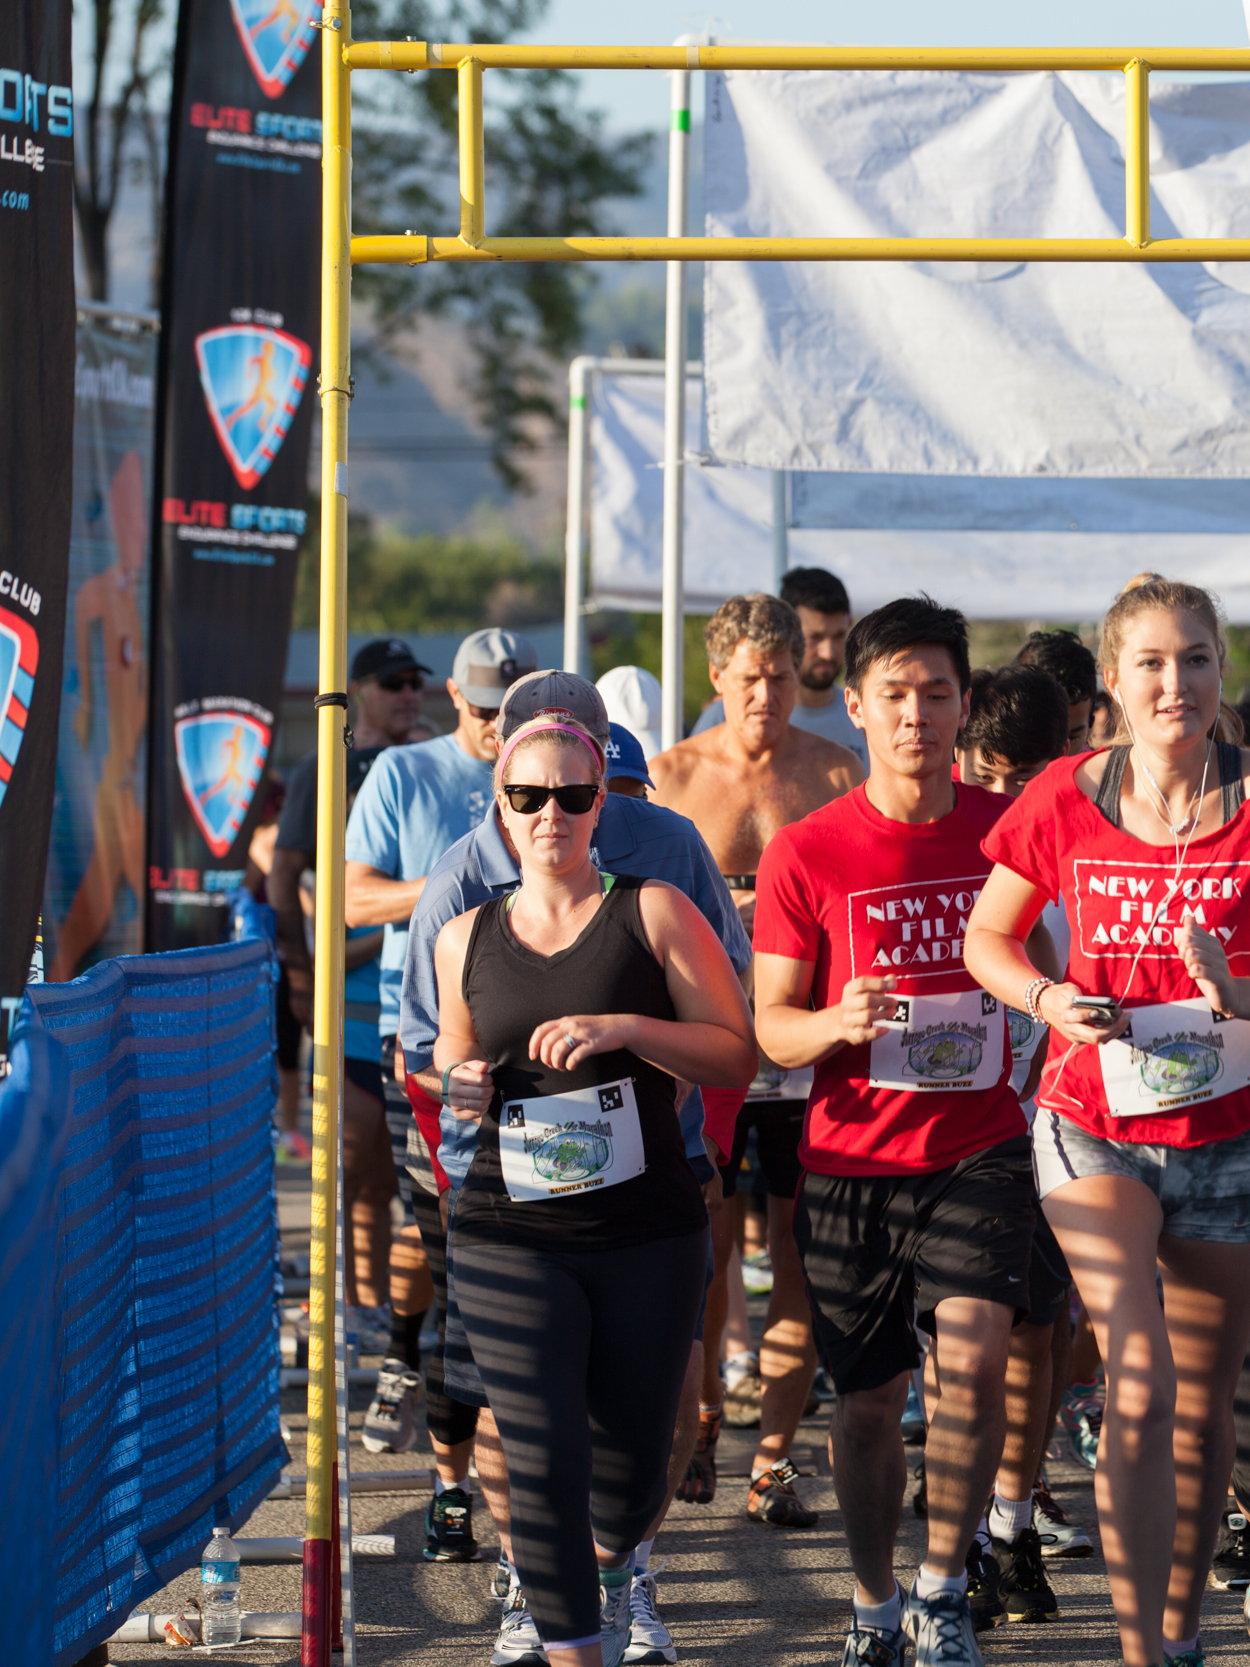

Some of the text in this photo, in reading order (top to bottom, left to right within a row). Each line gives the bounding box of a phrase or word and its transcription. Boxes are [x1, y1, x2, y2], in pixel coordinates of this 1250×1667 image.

[0, 569, 42, 616] CLUB
[1088, 874, 1243, 900] NEW YORK
[866, 896, 928, 924] NEW
[1120, 900, 1207, 925] FILM
[951, 1081, 973, 1089] BUZZ
[1157, 1089, 1214, 1108] RUNNER BUZZ
[544, 1122, 563, 1138] Creek
[549, 1178, 605, 1195] RUNNER BUZZ
